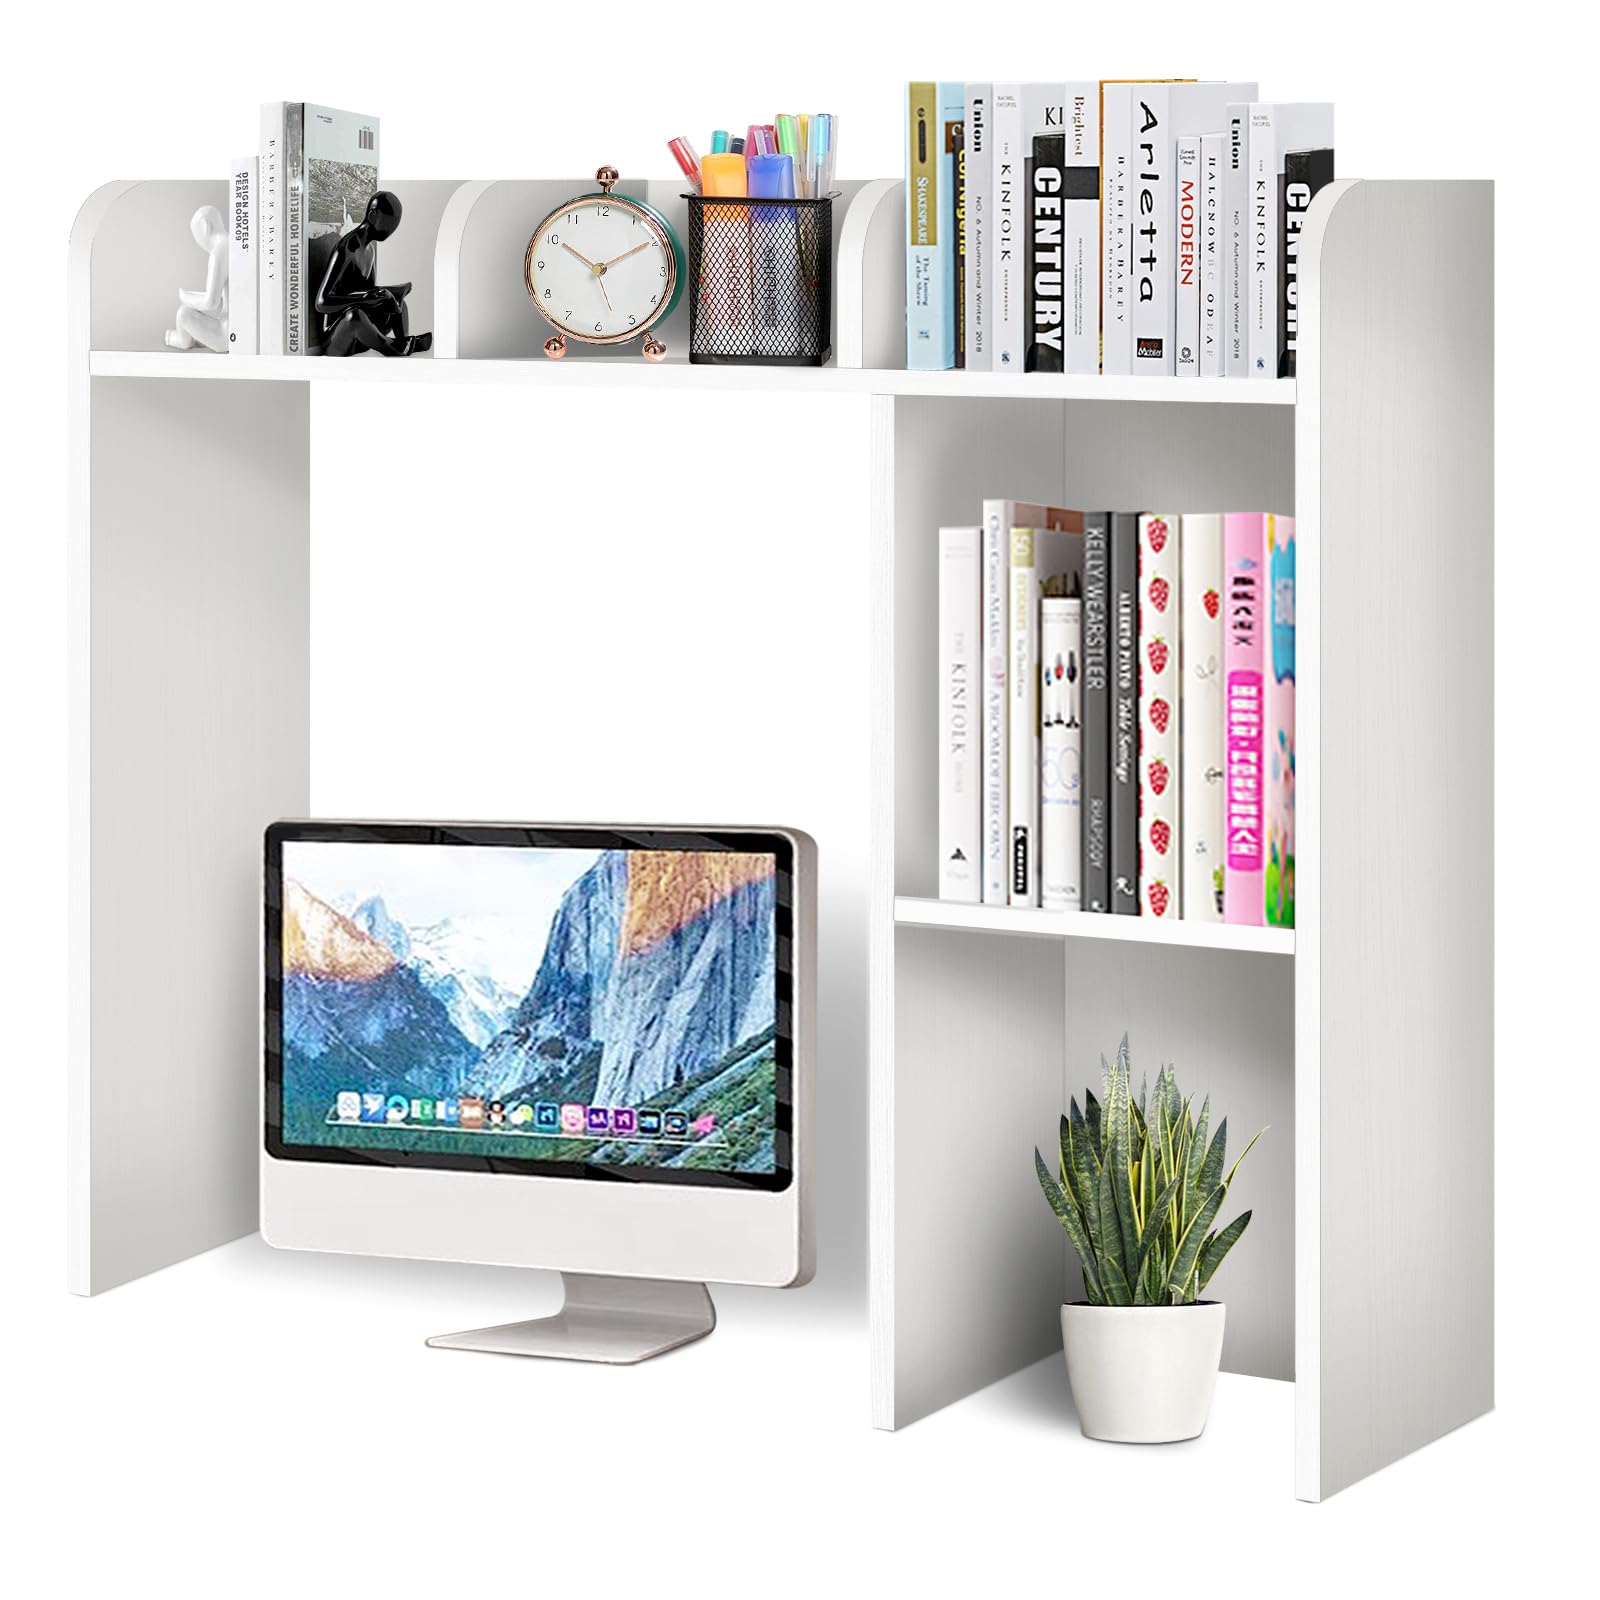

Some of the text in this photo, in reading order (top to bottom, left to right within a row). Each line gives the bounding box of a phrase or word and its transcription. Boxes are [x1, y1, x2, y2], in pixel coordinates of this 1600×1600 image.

[973, 98, 983, 152] Union
[1072, 96, 1085, 155] Brightest
[1231, 119, 1241, 169] Union
[597, 206, 610, 217] 12
[1001, 165, 1011, 260] KINFOLK
[1140, 101, 1159, 302] Arletta
[568, 214, 578, 225] 11
[632, 215, 636, 225] 1
[1180, 181, 1194, 285] MODERN
[1256, 181, 1266, 272] KINFOLK
[547, 234, 559, 245] 10
[289, 185, 300, 353] CREATE WONDERFUL HOMELIFE
[537, 260, 545, 271] 9
[660, 266, 666, 277] 3
[1034, 167, 1062, 350] CENTURY
[544, 288, 552, 299] 8
[650, 295, 657, 305] 4
[565, 310, 573, 320] 7
[594, 321, 603, 332] 6
[629, 315, 636, 325] 5
[1086, 528, 1105, 689] KELLY WEARSTLER
[951, 662, 967, 754] KINFOLK
